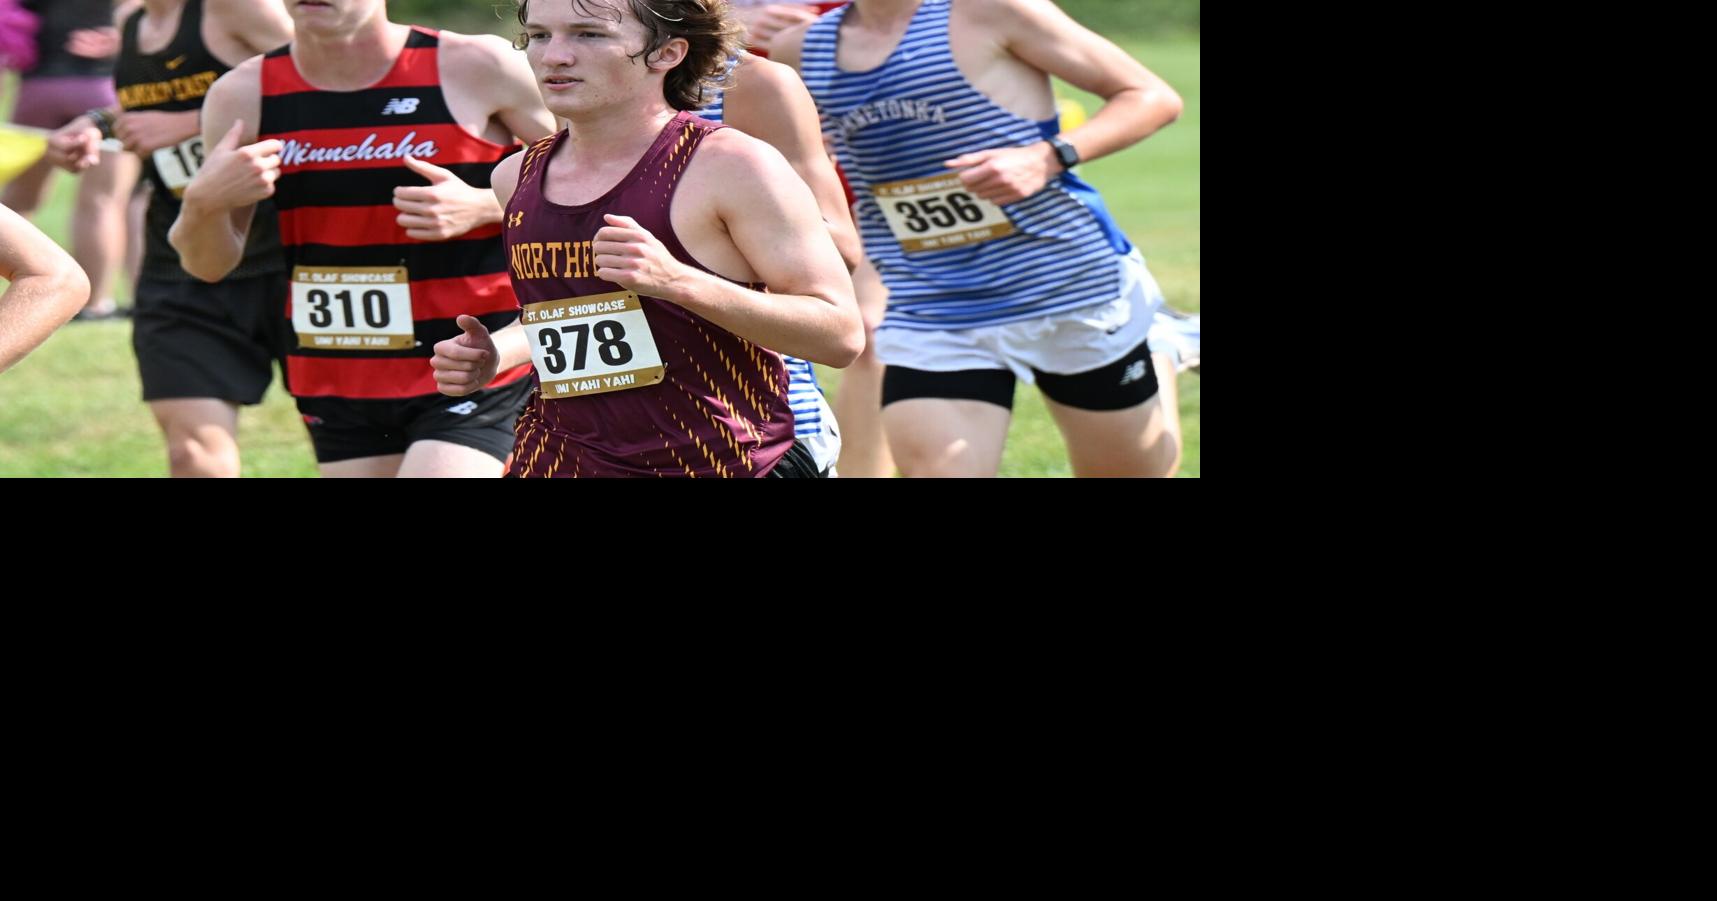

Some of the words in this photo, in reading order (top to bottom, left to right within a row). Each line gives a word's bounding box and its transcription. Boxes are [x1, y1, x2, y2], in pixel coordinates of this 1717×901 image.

[278, 131, 438, 166] Minnehaha
[894, 192, 984, 234] 356
[306, 288, 391, 329] 310
[540, 307, 565, 320] OLAF
[568, 299, 626, 317] SHOWCASE
[538, 319, 633, 374] 378
